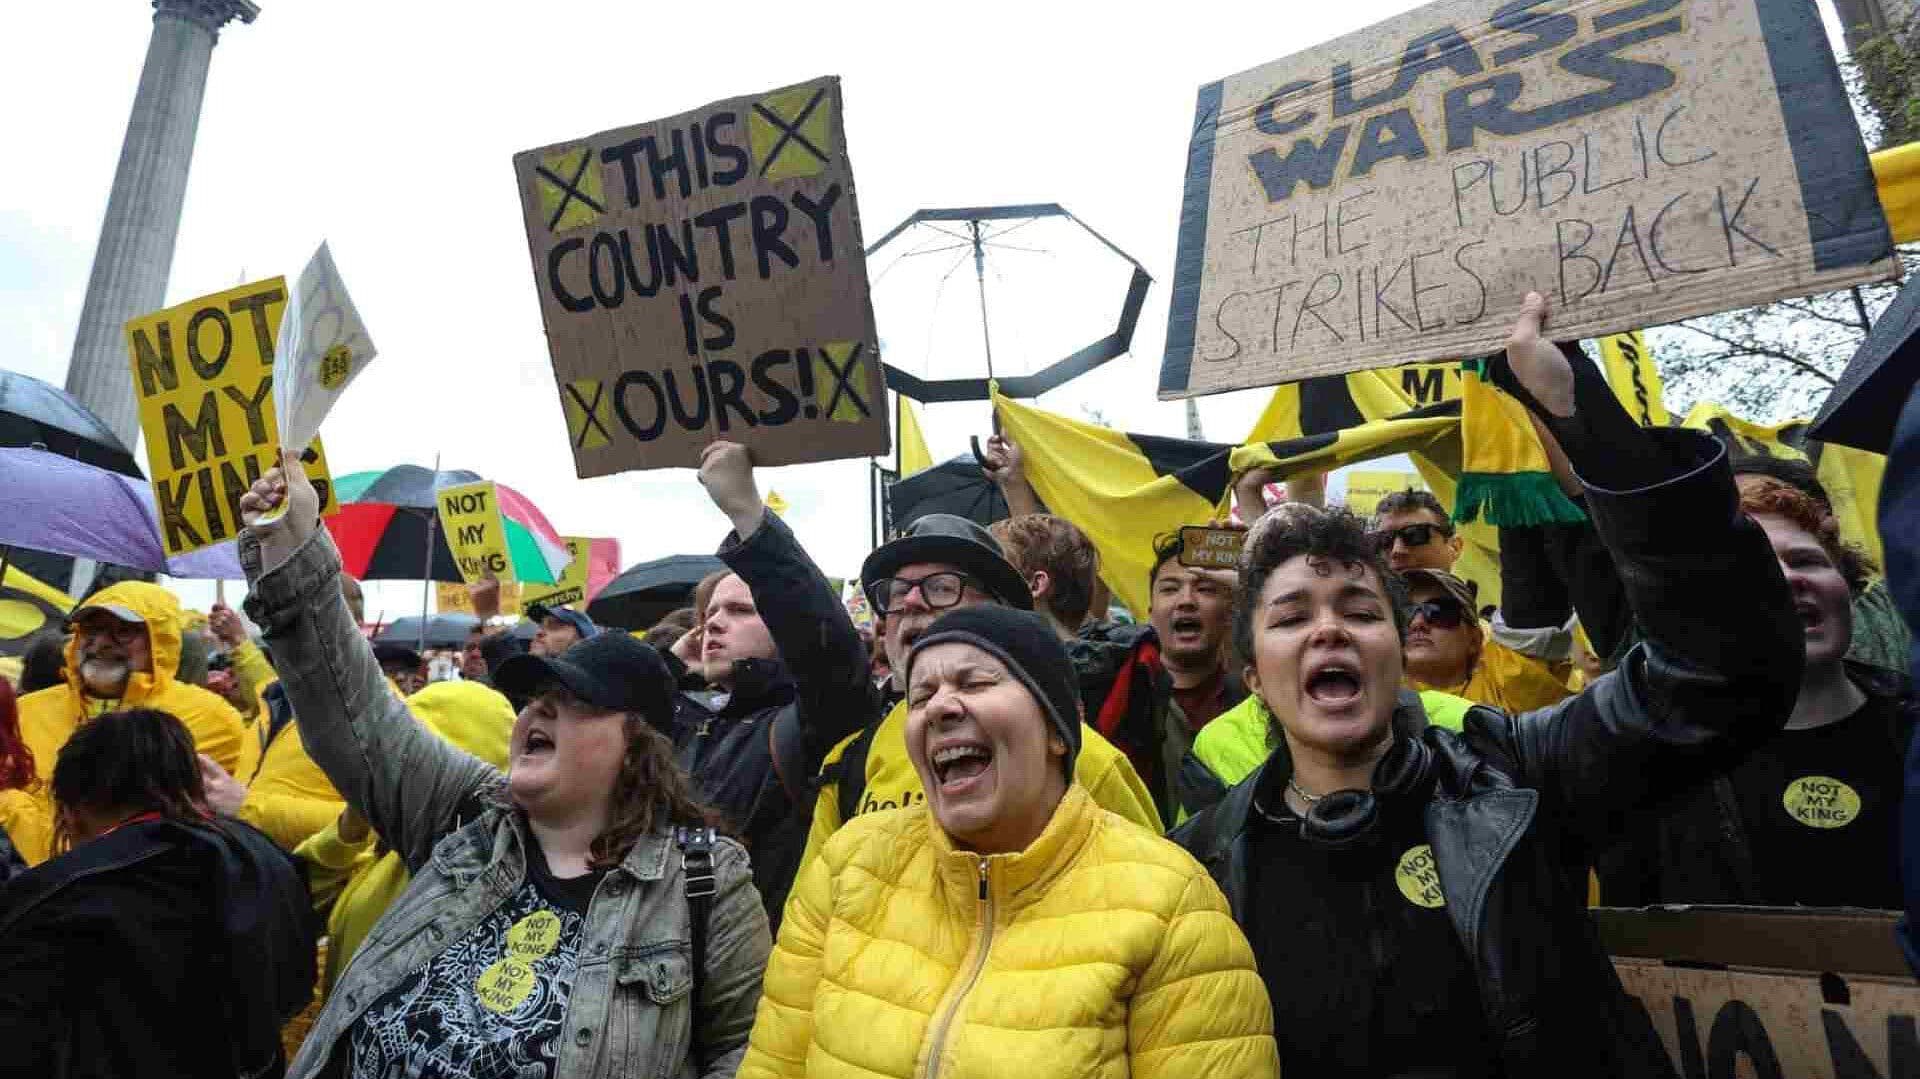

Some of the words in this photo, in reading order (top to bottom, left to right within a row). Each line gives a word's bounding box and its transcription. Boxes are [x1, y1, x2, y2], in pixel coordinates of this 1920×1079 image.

[1248, 16, 1682, 202] WARS
[600, 111, 748, 208] THIS
[1231, 189, 1375, 274] THE
[1452, 104, 1717, 226] PUBLIC
[546, 183, 842, 313] COUNTRY
[1203, 240, 1487, 363] STRIKES
[1555, 177, 1783, 306] BACK
[679, 285, 735, 356] IS
[131, 288, 284, 397] NOT
[613, 346, 818, 442] OURS!
[161, 374, 273, 471] MY
[445, 491, 488, 515] NOT
[457, 524, 485, 547] MY
[1206, 533, 1232, 547] NOT
[1801, 781, 1841, 796] NOT
[1807, 795, 1836, 807] MY
[1797, 807, 1848, 821] KING
[527, 918, 554, 929] NOT
[511, 942, 546, 954] KING
[524, 931, 545, 942] MY
[501, 962, 528, 981] NOT
[495, 976, 517, 992] MY
[480, 987, 513, 1007] KING
